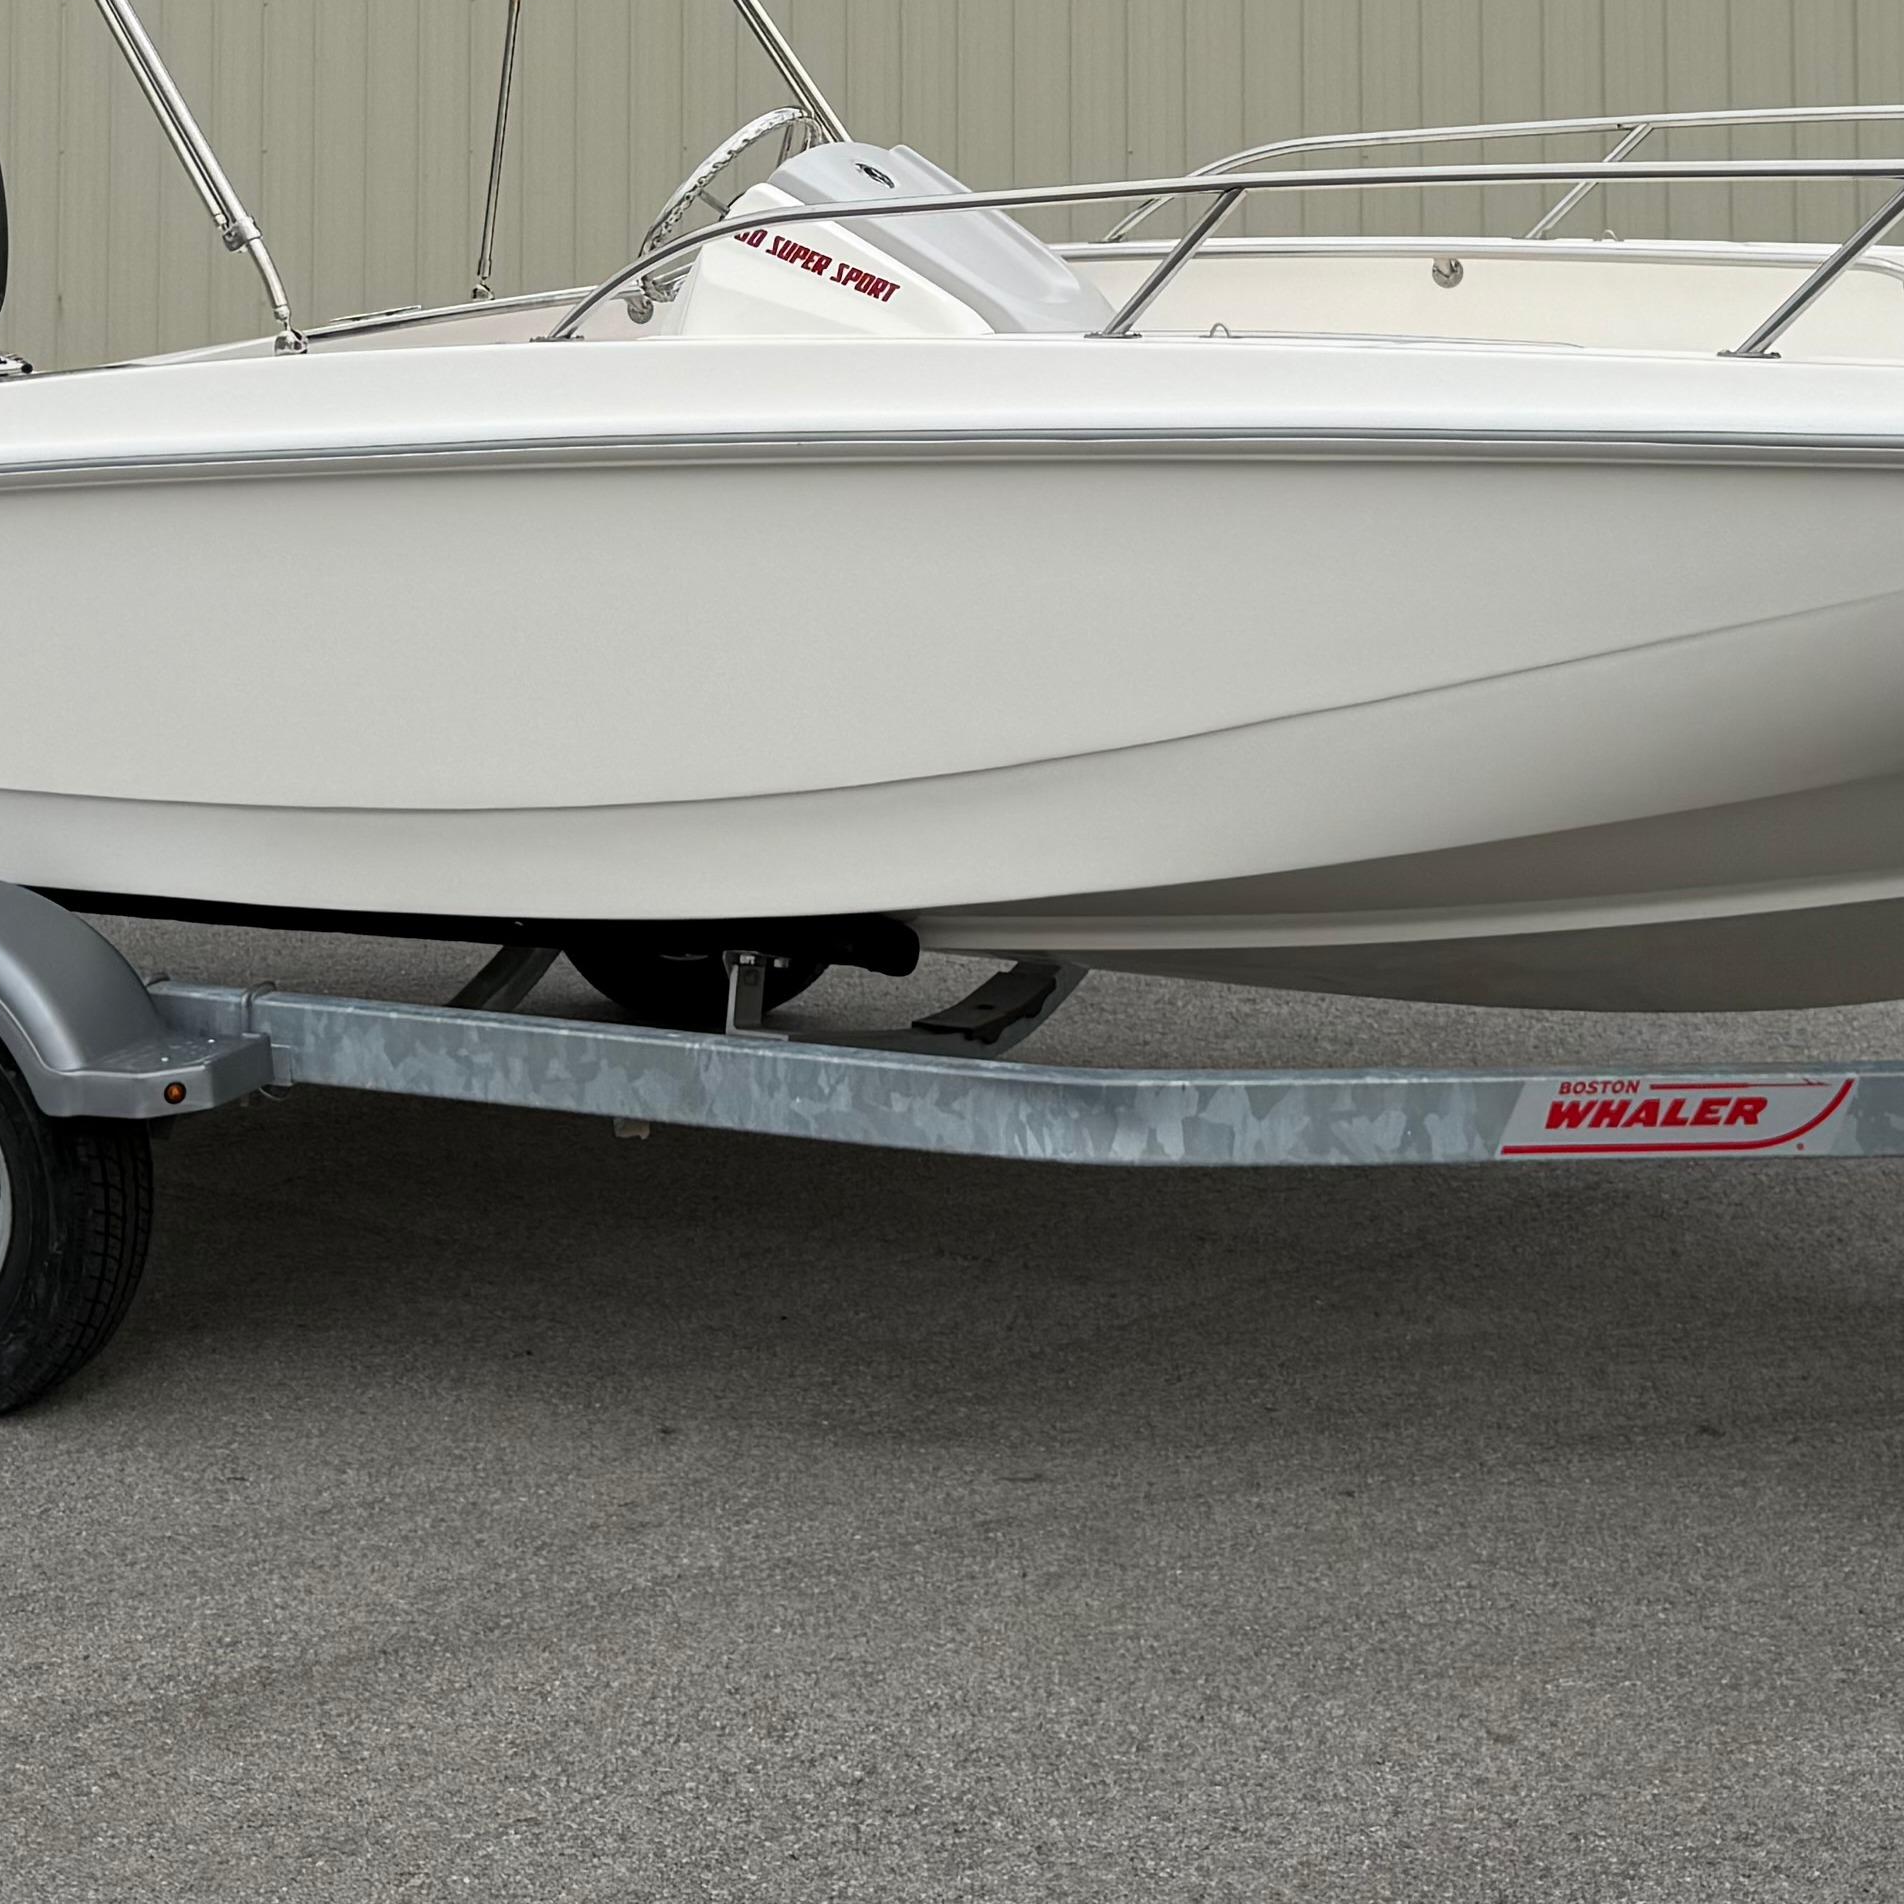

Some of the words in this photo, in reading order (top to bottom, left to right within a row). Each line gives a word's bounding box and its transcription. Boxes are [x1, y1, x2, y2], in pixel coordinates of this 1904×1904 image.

[765, 235, 832, 276] SUPER
[830, 263, 900, 302] SPORT
[1558, 1080, 1640, 1096] BOSTON
[1545, 1096, 1767, 1130] WHALER
